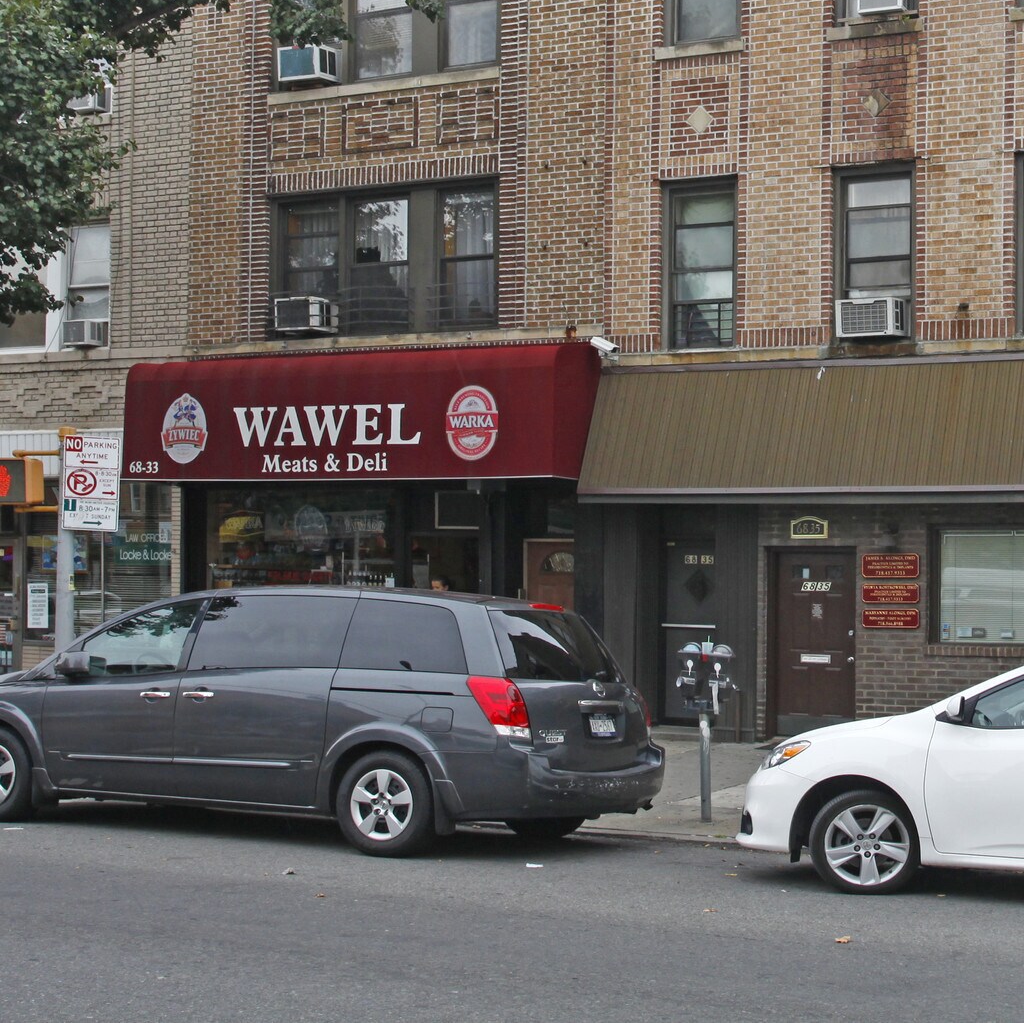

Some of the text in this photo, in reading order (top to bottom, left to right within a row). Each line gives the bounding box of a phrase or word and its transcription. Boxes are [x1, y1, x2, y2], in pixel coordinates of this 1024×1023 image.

[233, 403, 422, 447] WAWEL
[449, 415, 494, 428] WARKA
[66, 439, 117, 450] NO PARKING
[129, 461, 159, 473] 68-33
[261, 452, 388, 473] Meats & Deli
[796, 523, 821, 534] 6835
[125, 533, 138, 542] LAW
[119, 549, 173, 561] Locke & Locke
[802, 582, 831, 591] 6835
